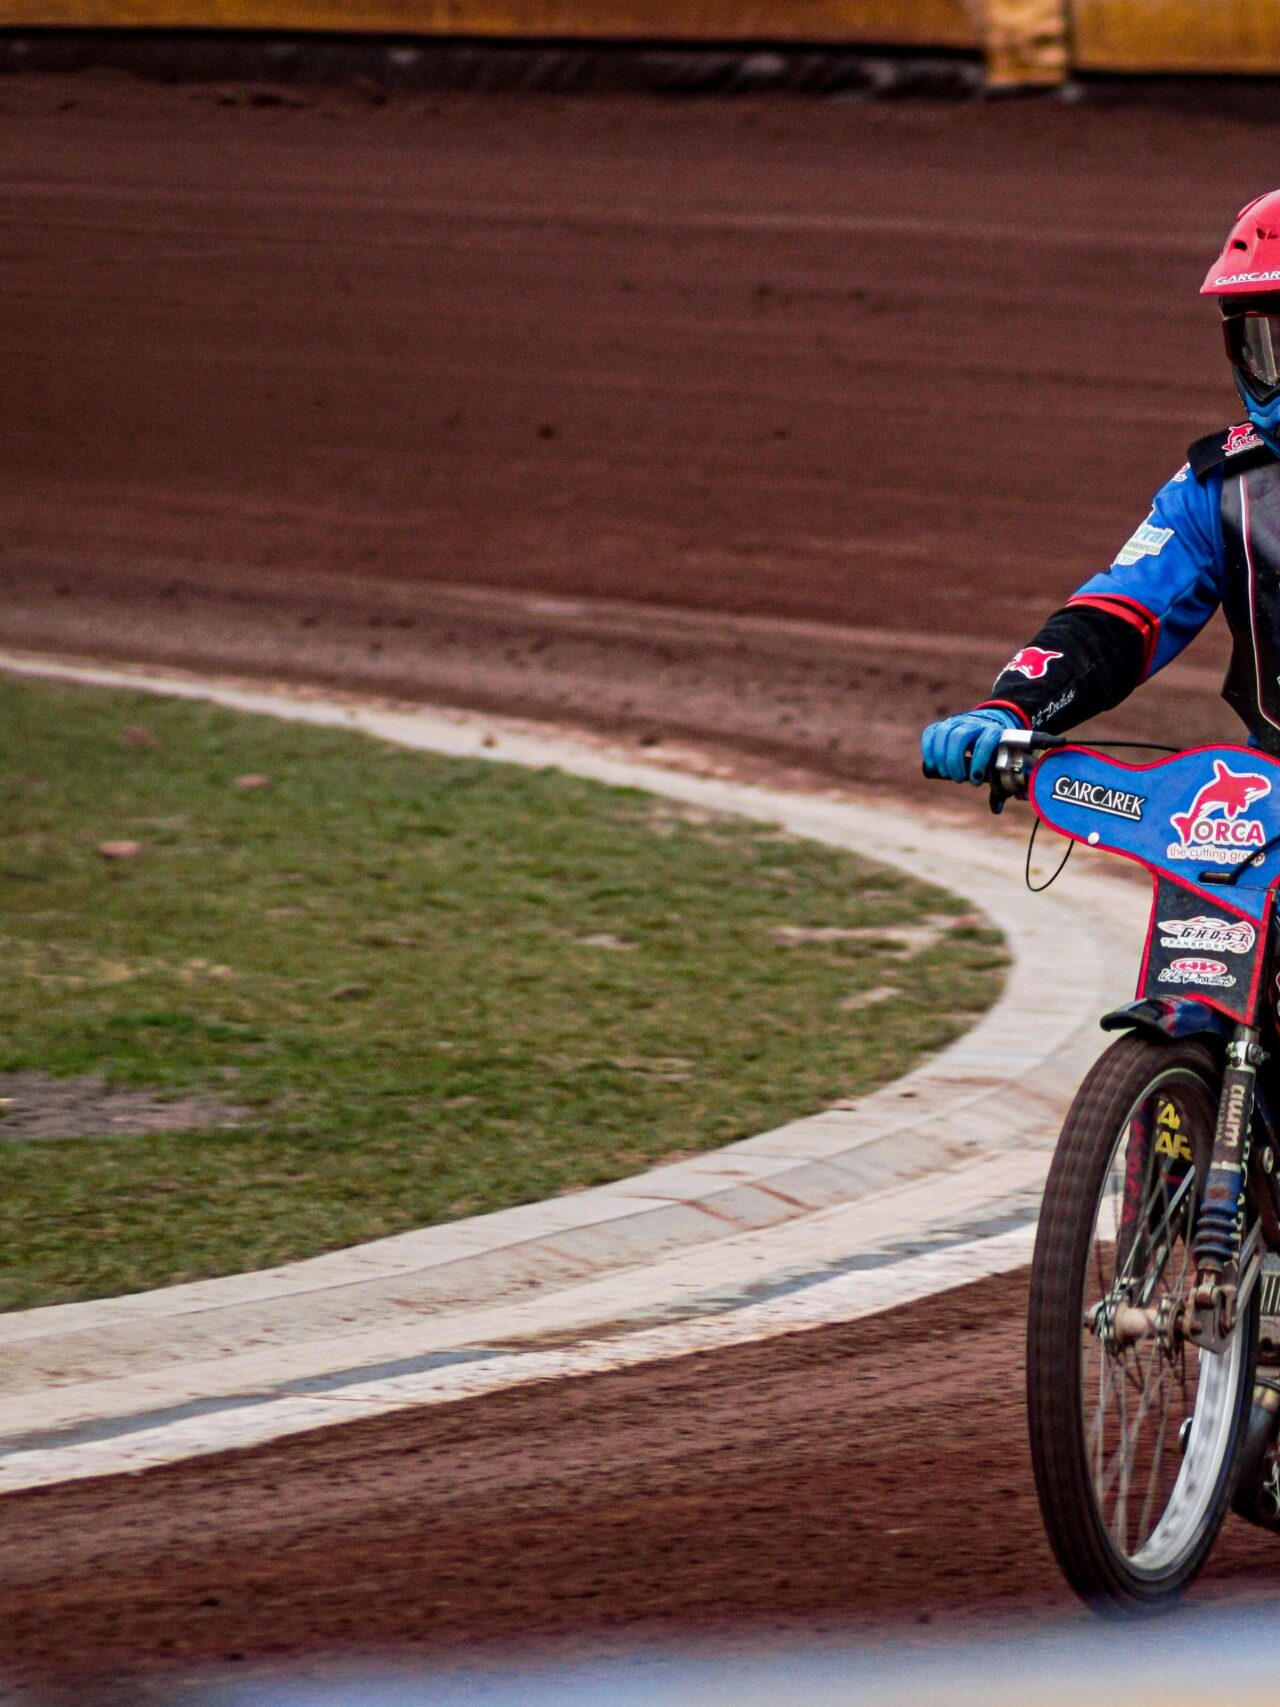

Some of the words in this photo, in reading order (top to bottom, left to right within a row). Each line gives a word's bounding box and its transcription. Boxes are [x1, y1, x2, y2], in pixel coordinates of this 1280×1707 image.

[1055, 776, 1145, 815] GARCAREK
[1194, 820, 1265, 844] ORCA
[1169, 844, 1187, 857] the
[1190, 846, 1227, 862] cutting
[1230, 851, 1265, 866] grop
[1162, 938, 1226, 950] TRANSPORT
[1180, 927, 1248, 942] GHOST
